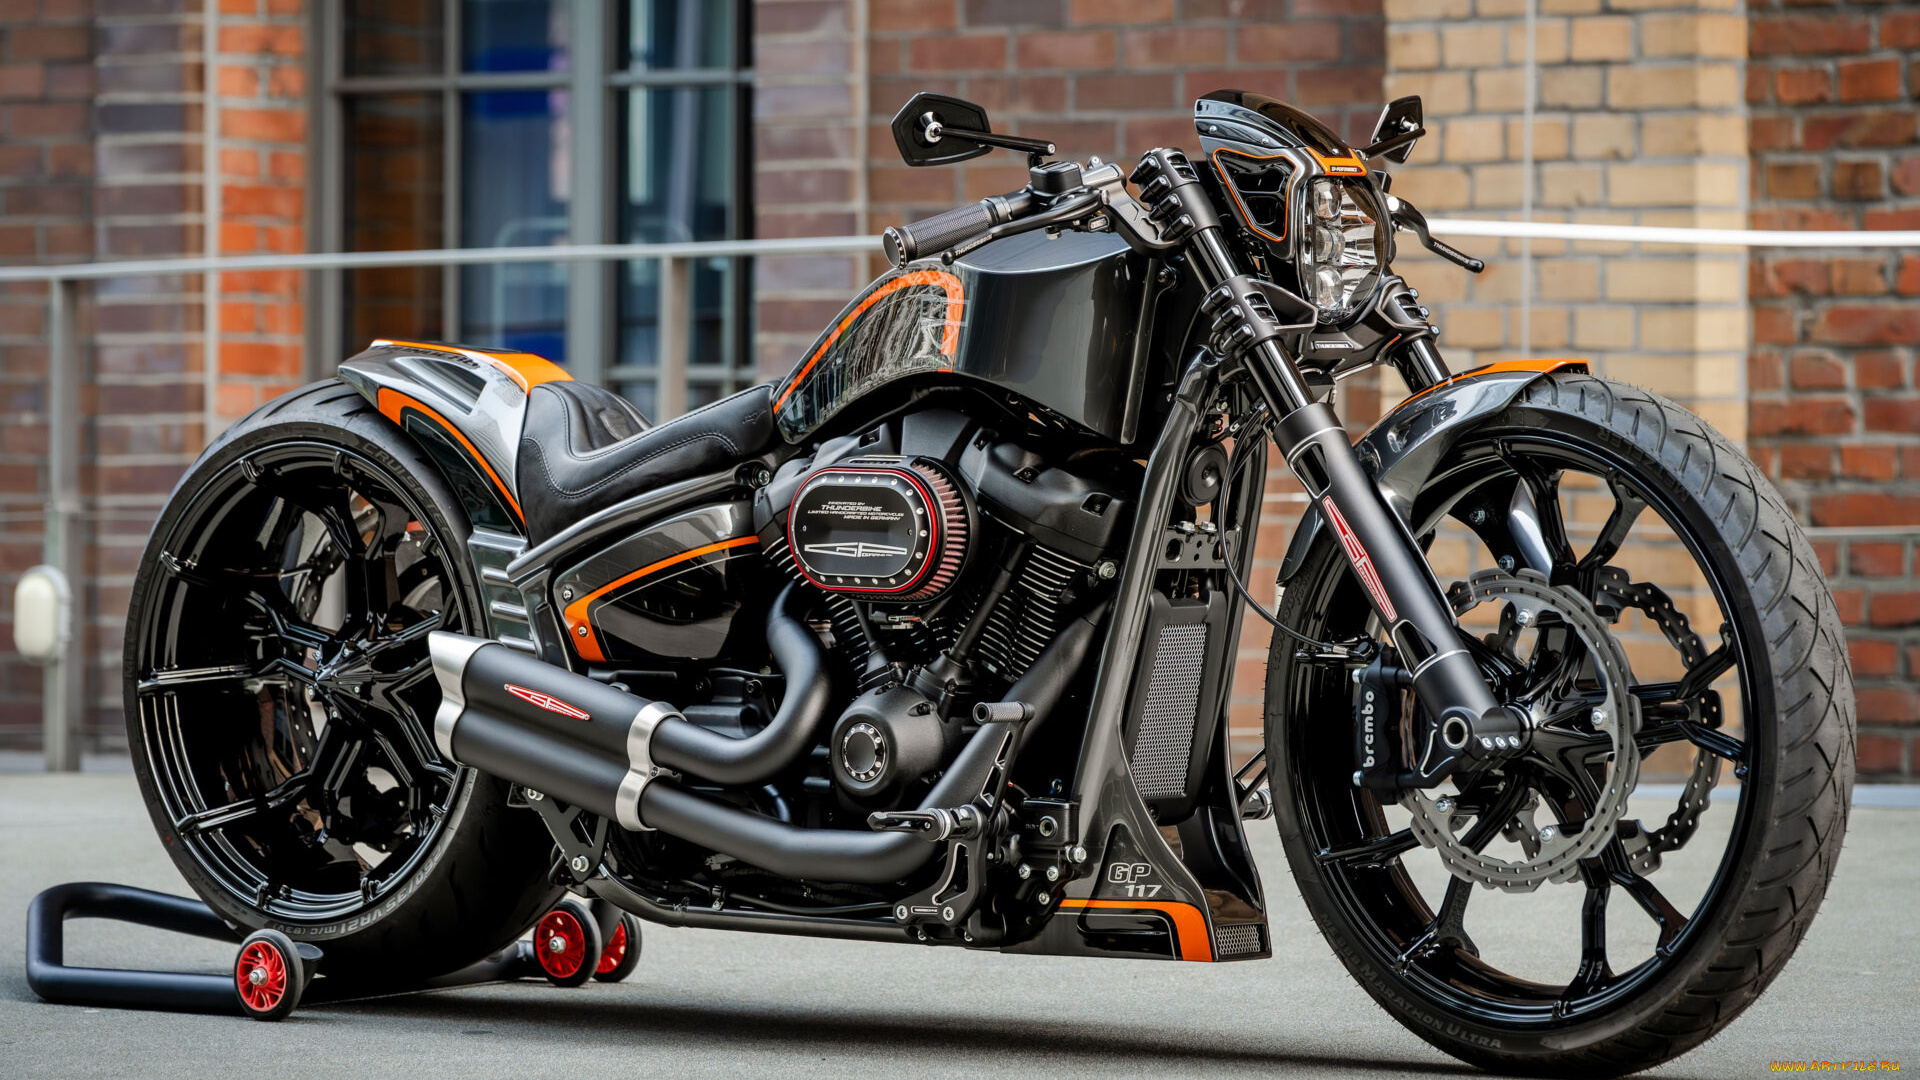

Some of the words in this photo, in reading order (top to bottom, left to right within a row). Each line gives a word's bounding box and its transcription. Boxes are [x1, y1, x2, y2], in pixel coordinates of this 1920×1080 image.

[362, 442, 454, 541] CRUISETEC
[821, 504, 883, 512] THUNDERBIKE
[1361, 690, 1375, 767] brembo
[1107, 862, 1151, 884] GP
[1125, 884, 1162, 898] 117
[340, 910, 383, 934] VR21
[1360, 962, 1445, 1031] MARATHON
[1446, 1022, 1502, 1049] ULTRA
